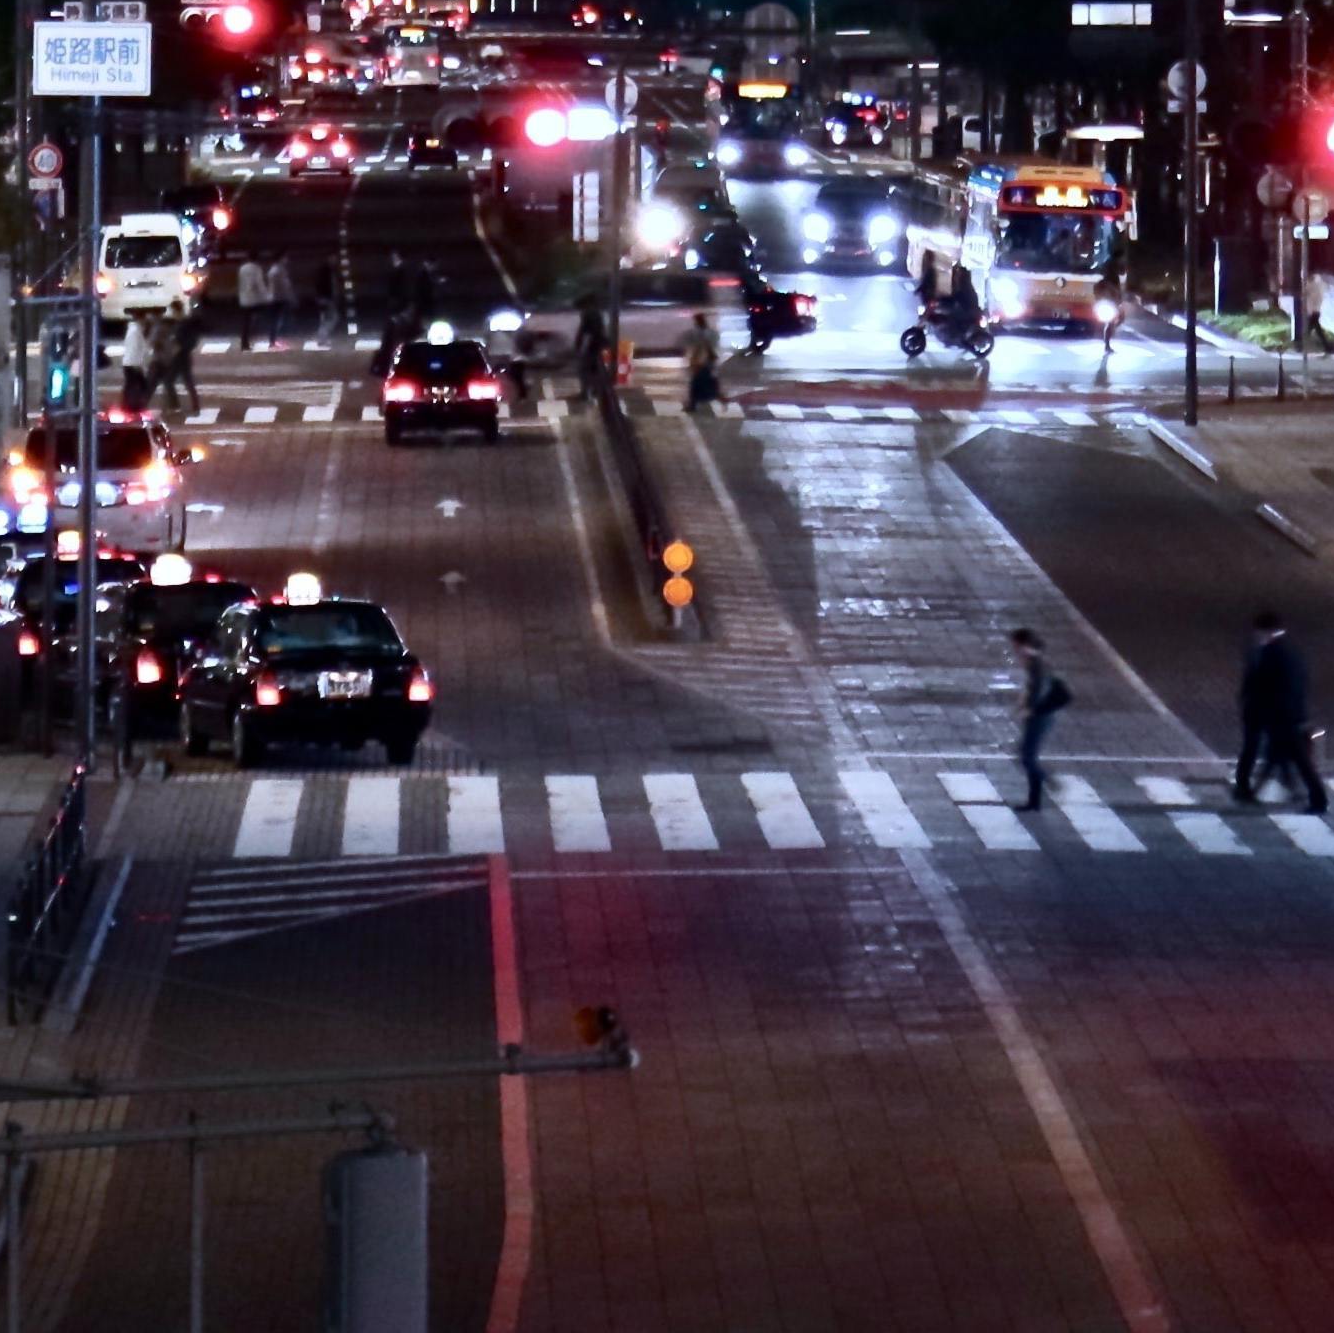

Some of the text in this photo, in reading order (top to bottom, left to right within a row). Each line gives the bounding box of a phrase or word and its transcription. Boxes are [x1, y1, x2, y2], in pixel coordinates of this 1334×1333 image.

[44, 37, 140, 66] 姫路駅前
[50, 67, 100, 85] Himeji
